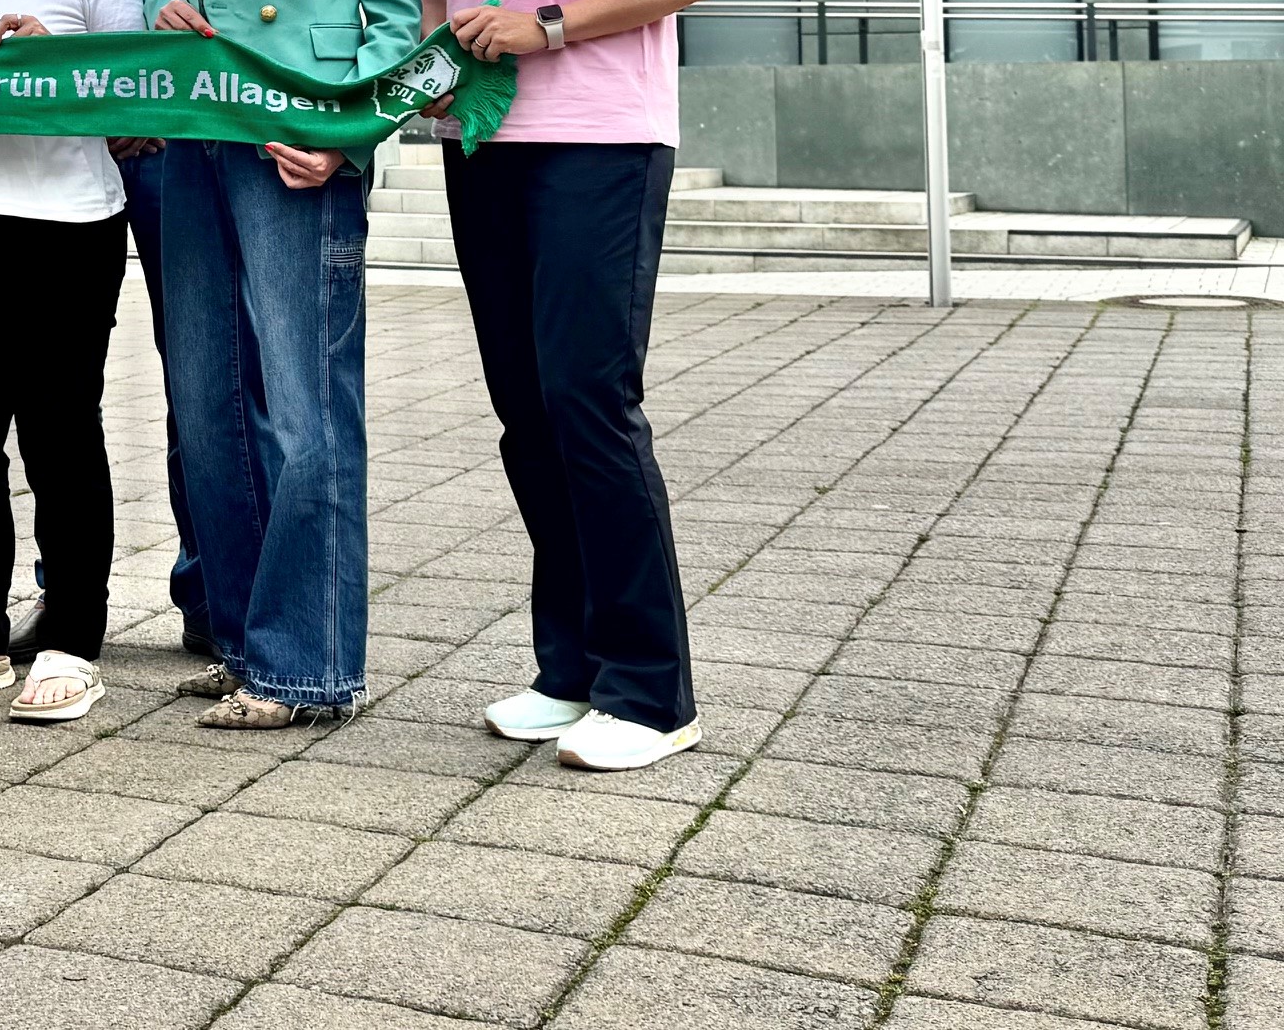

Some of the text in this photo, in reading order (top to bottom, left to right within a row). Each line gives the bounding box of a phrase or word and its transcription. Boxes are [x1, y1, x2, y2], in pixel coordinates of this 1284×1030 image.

[73, 69, 175, 100] Weiß
[190, 71, 342, 113] Allagen
[386, 84, 416, 106] TuS
[422, 78, 441, 94] 19
